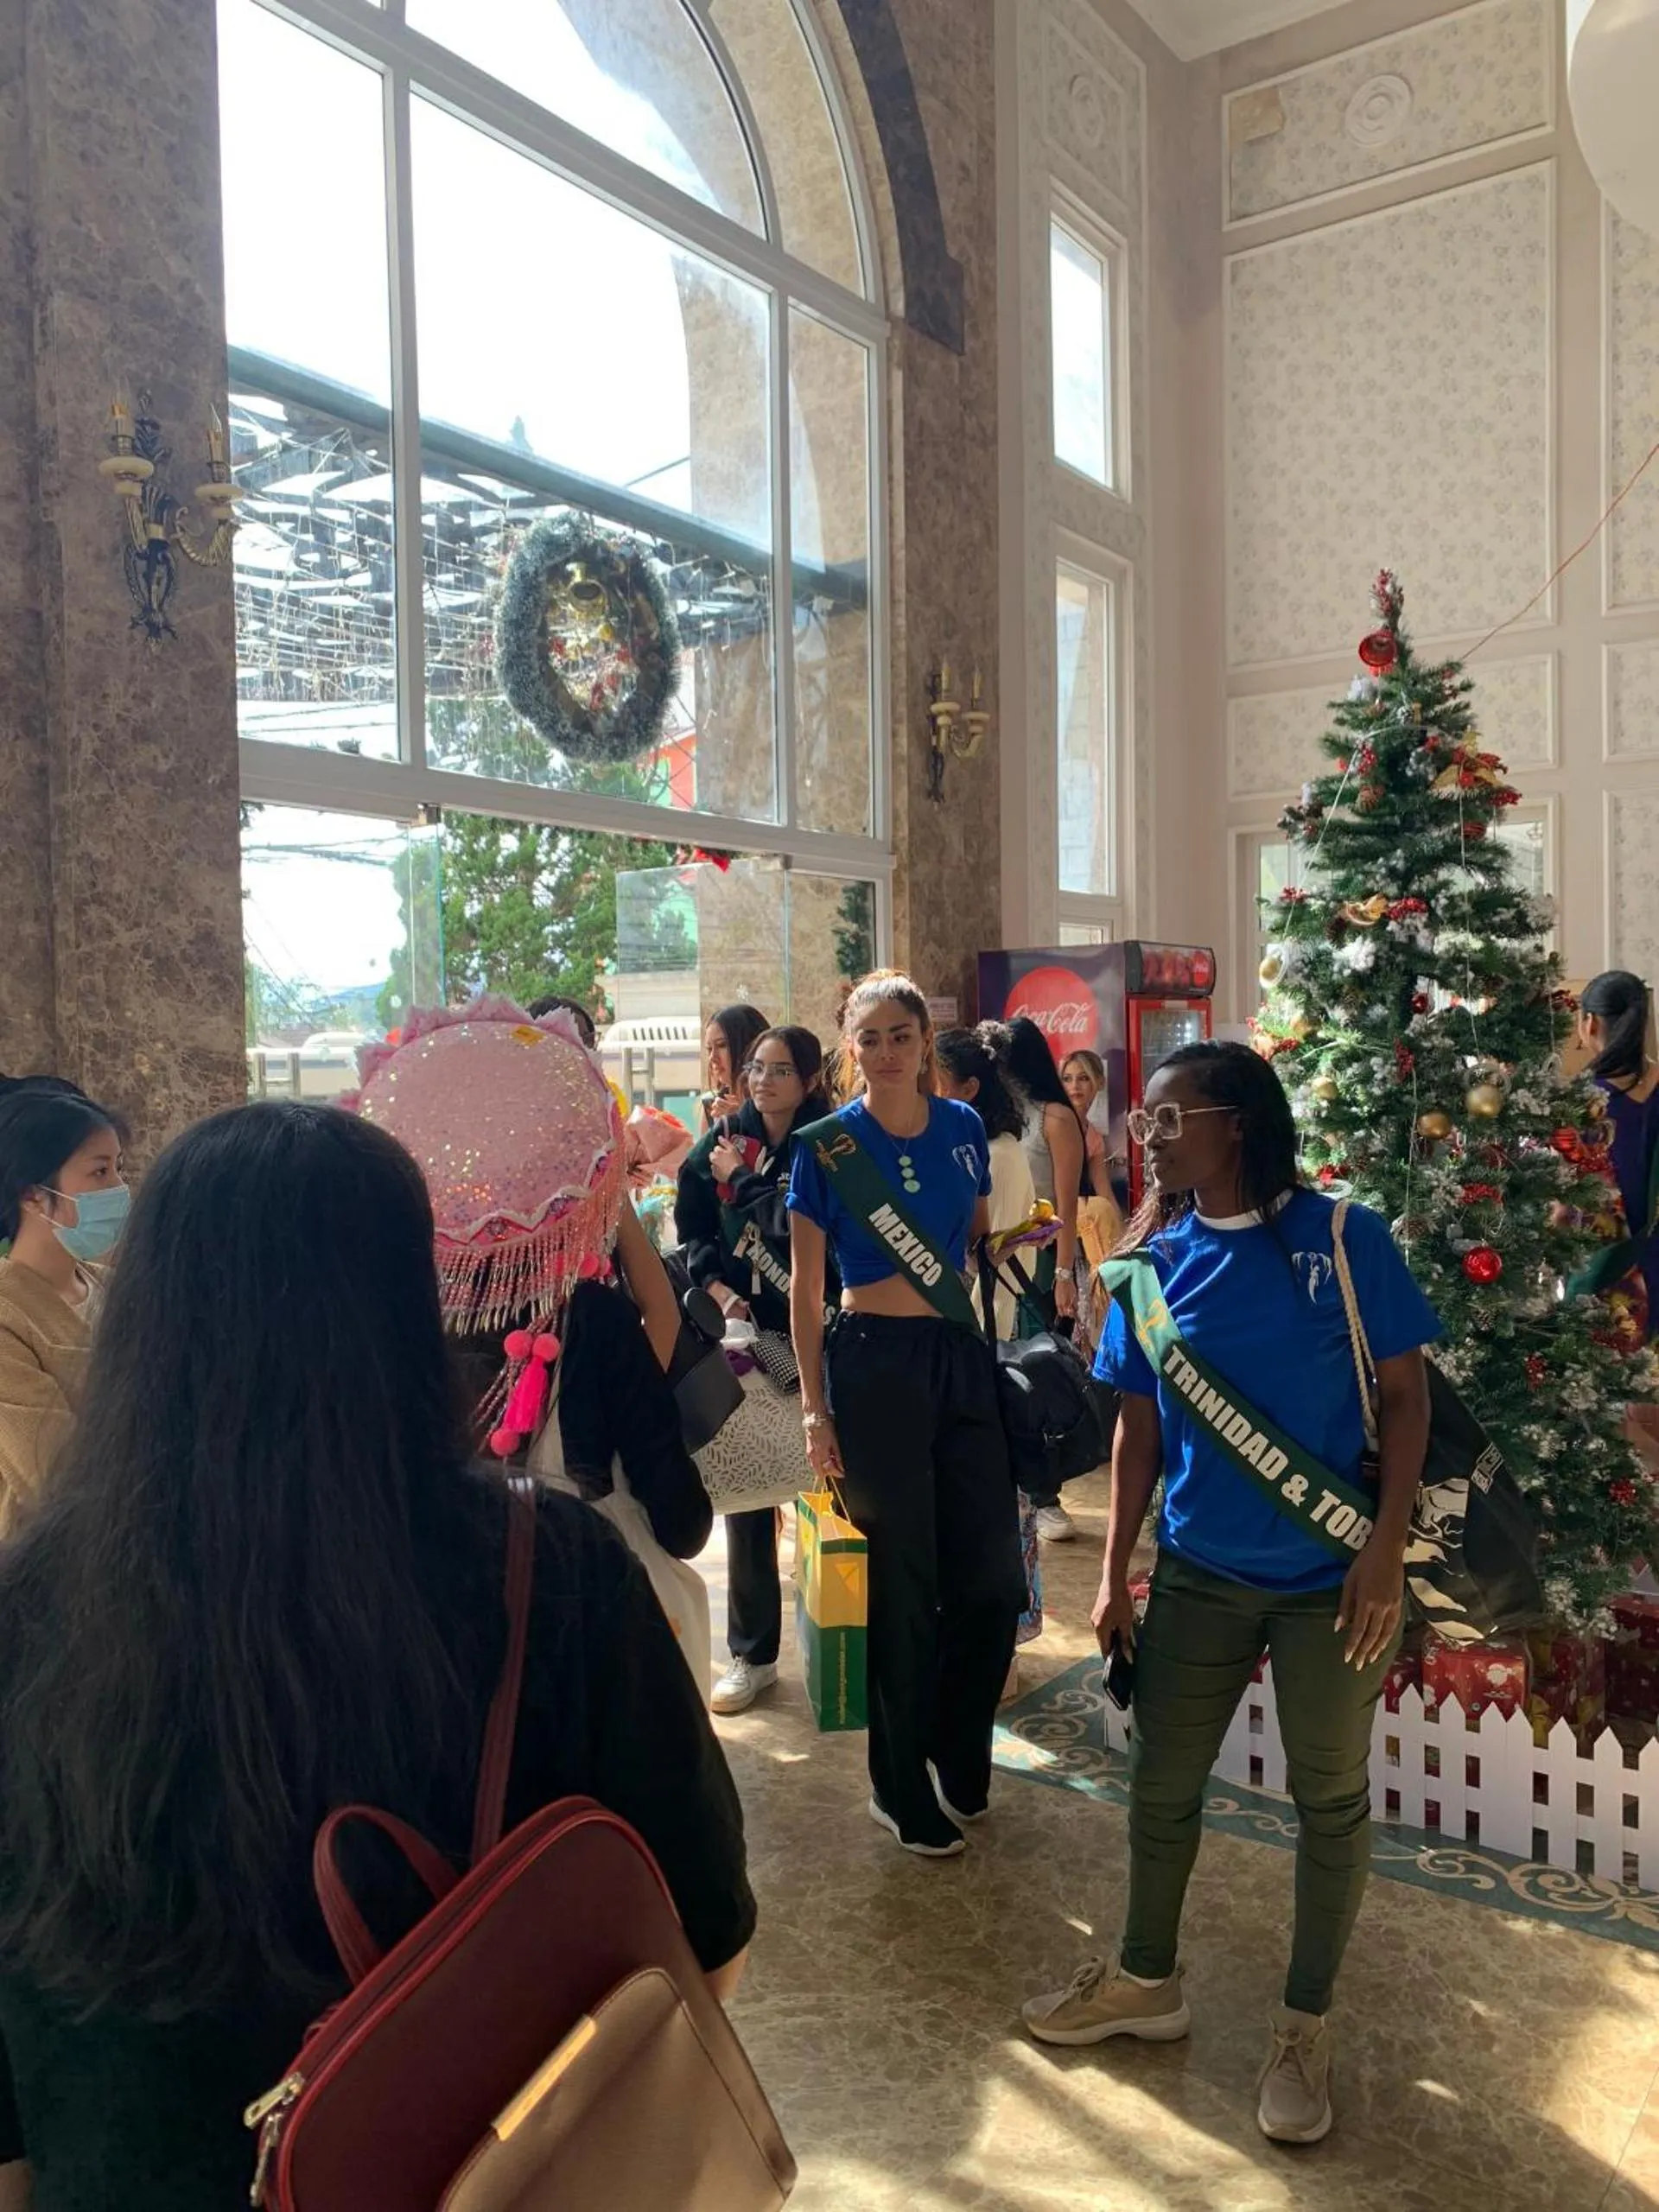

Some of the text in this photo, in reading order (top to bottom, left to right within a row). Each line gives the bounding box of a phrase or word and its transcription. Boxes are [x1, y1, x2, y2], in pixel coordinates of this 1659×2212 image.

[868, 1203, 944, 1287] MEXICO
[1163, 1344, 1290, 1482] TRINIDAD
[1281, 1474, 1307, 1507] &
